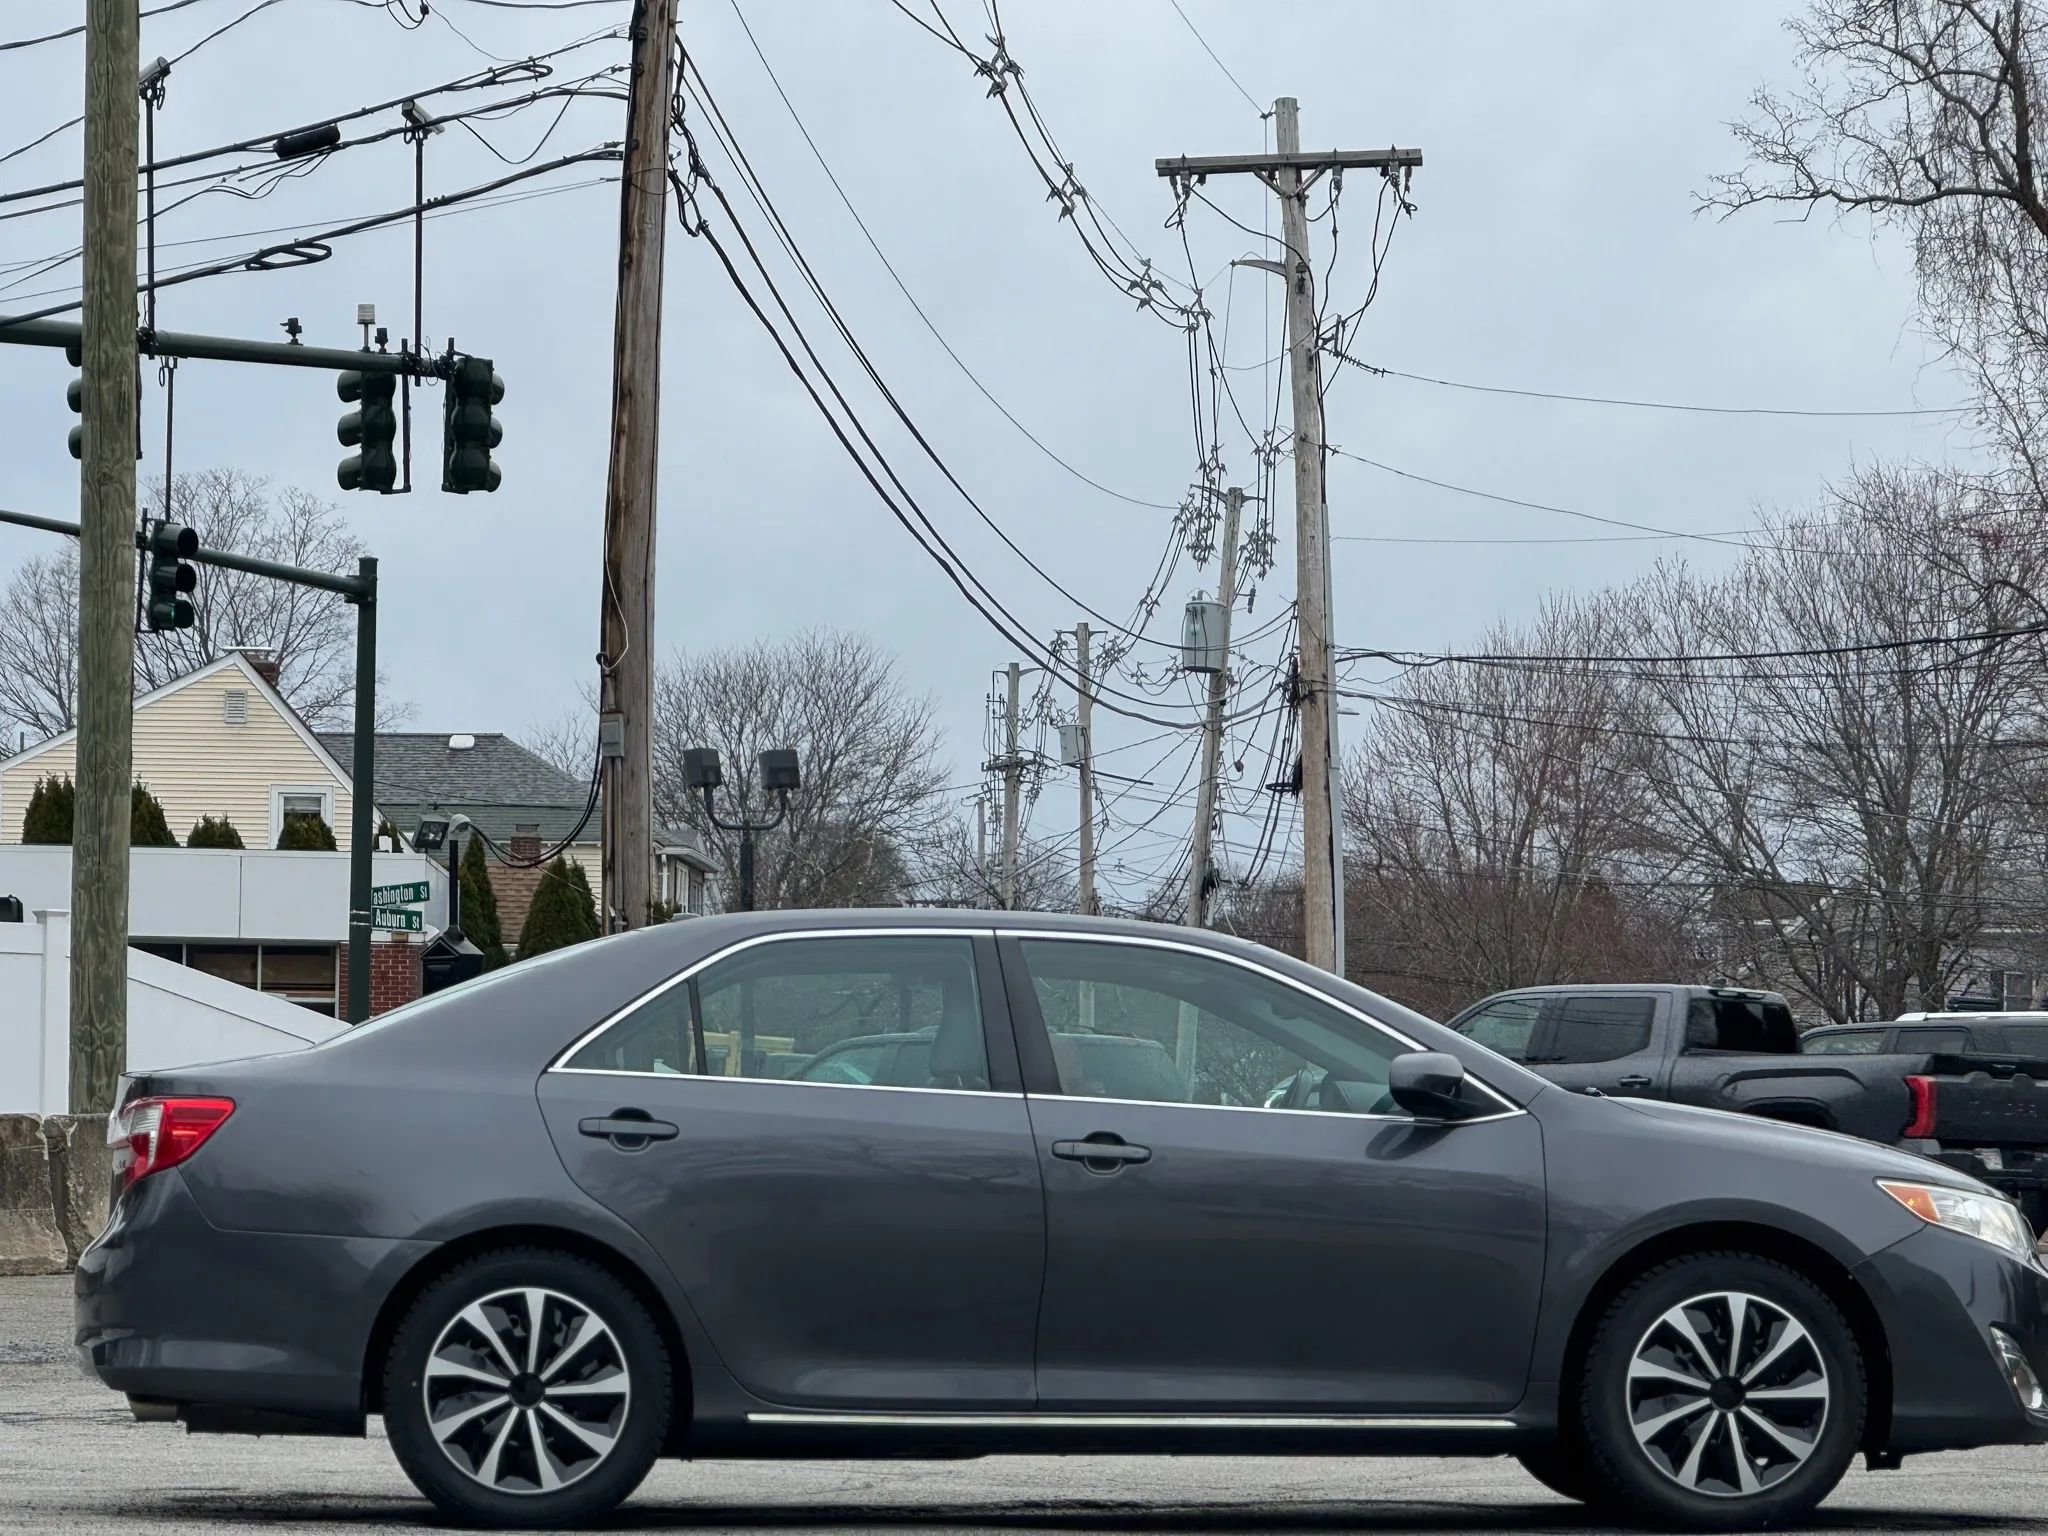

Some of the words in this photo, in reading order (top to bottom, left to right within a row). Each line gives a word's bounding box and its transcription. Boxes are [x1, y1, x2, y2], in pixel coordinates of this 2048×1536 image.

[371, 886, 413, 904] ashington
[420, 885, 427, 899] St
[375, 909, 405, 928] Auburn
[412, 915, 420, 929] St
